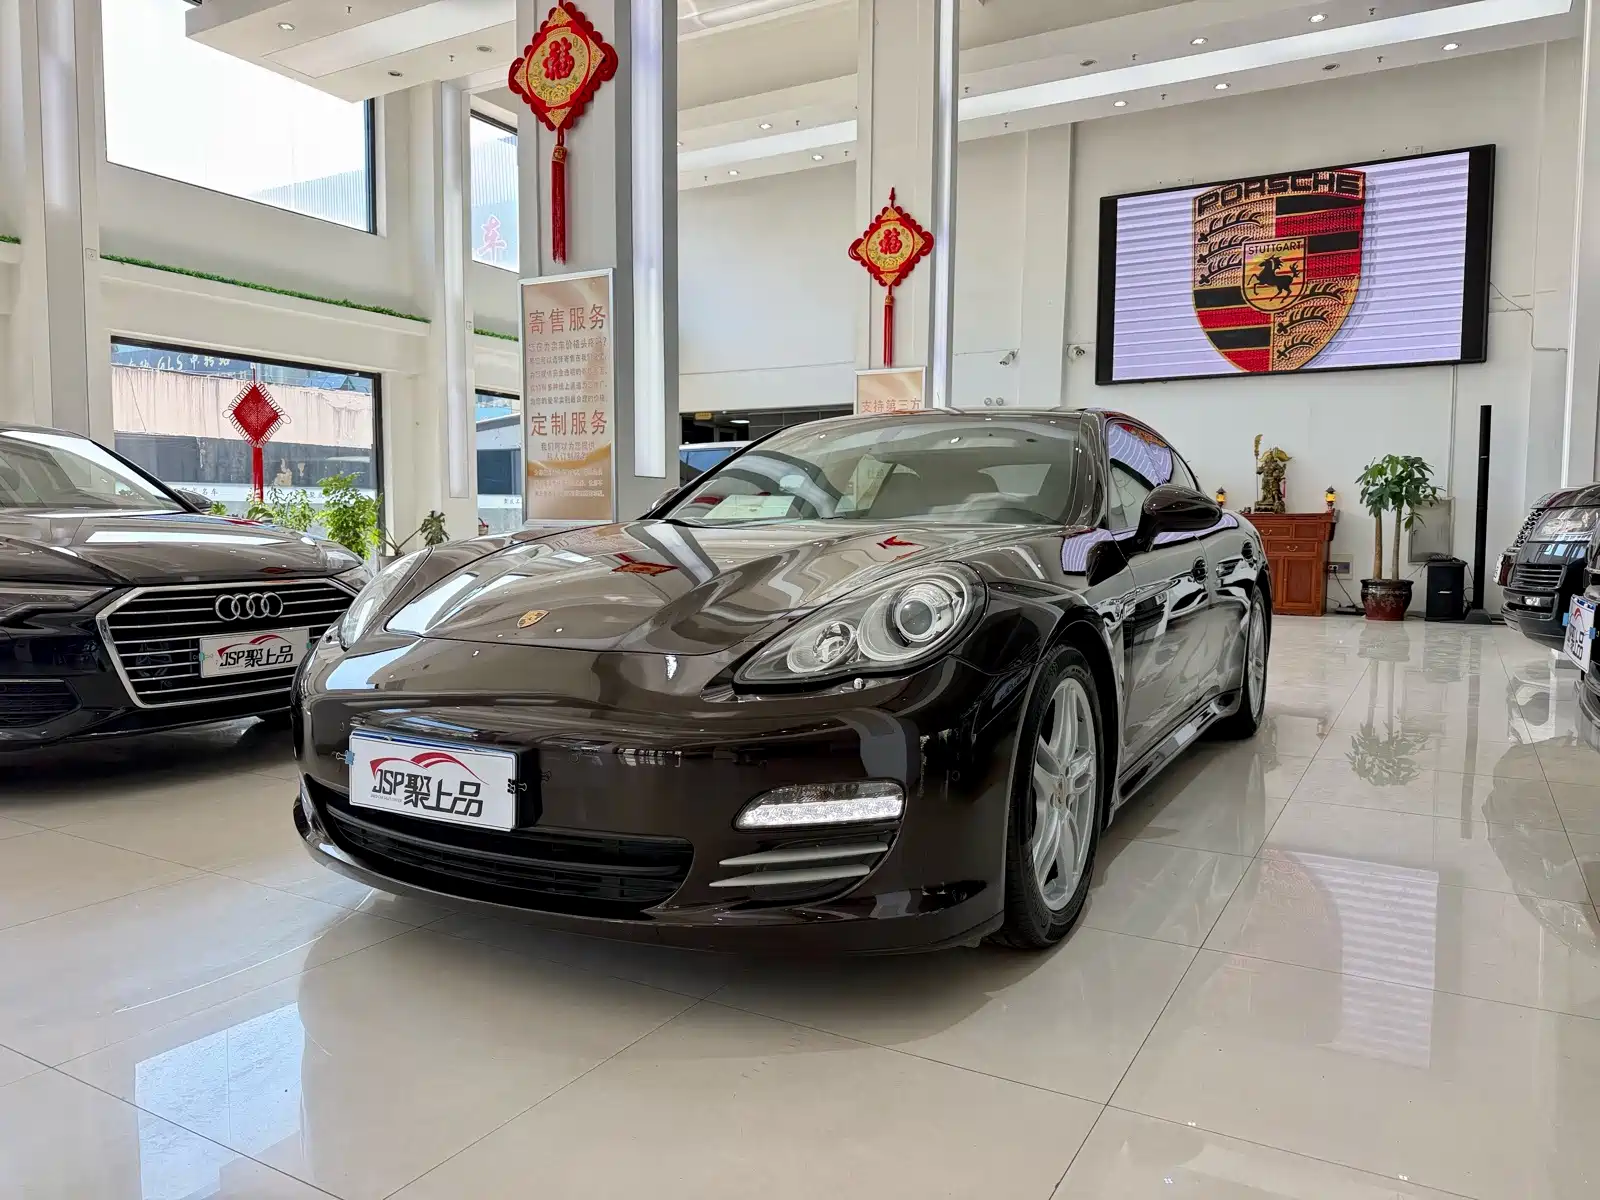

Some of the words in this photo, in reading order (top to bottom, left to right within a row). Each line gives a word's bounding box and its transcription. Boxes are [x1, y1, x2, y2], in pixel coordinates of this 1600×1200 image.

[542, 36, 575, 81] 福
[1197, 171, 1364, 217] PORSCHE
[878, 227, 903, 255] 福
[1248, 241, 1302, 255] STUTTGART
[529, 303, 606, 335] 寄售服务
[531, 409, 607, 436] 定制服务
